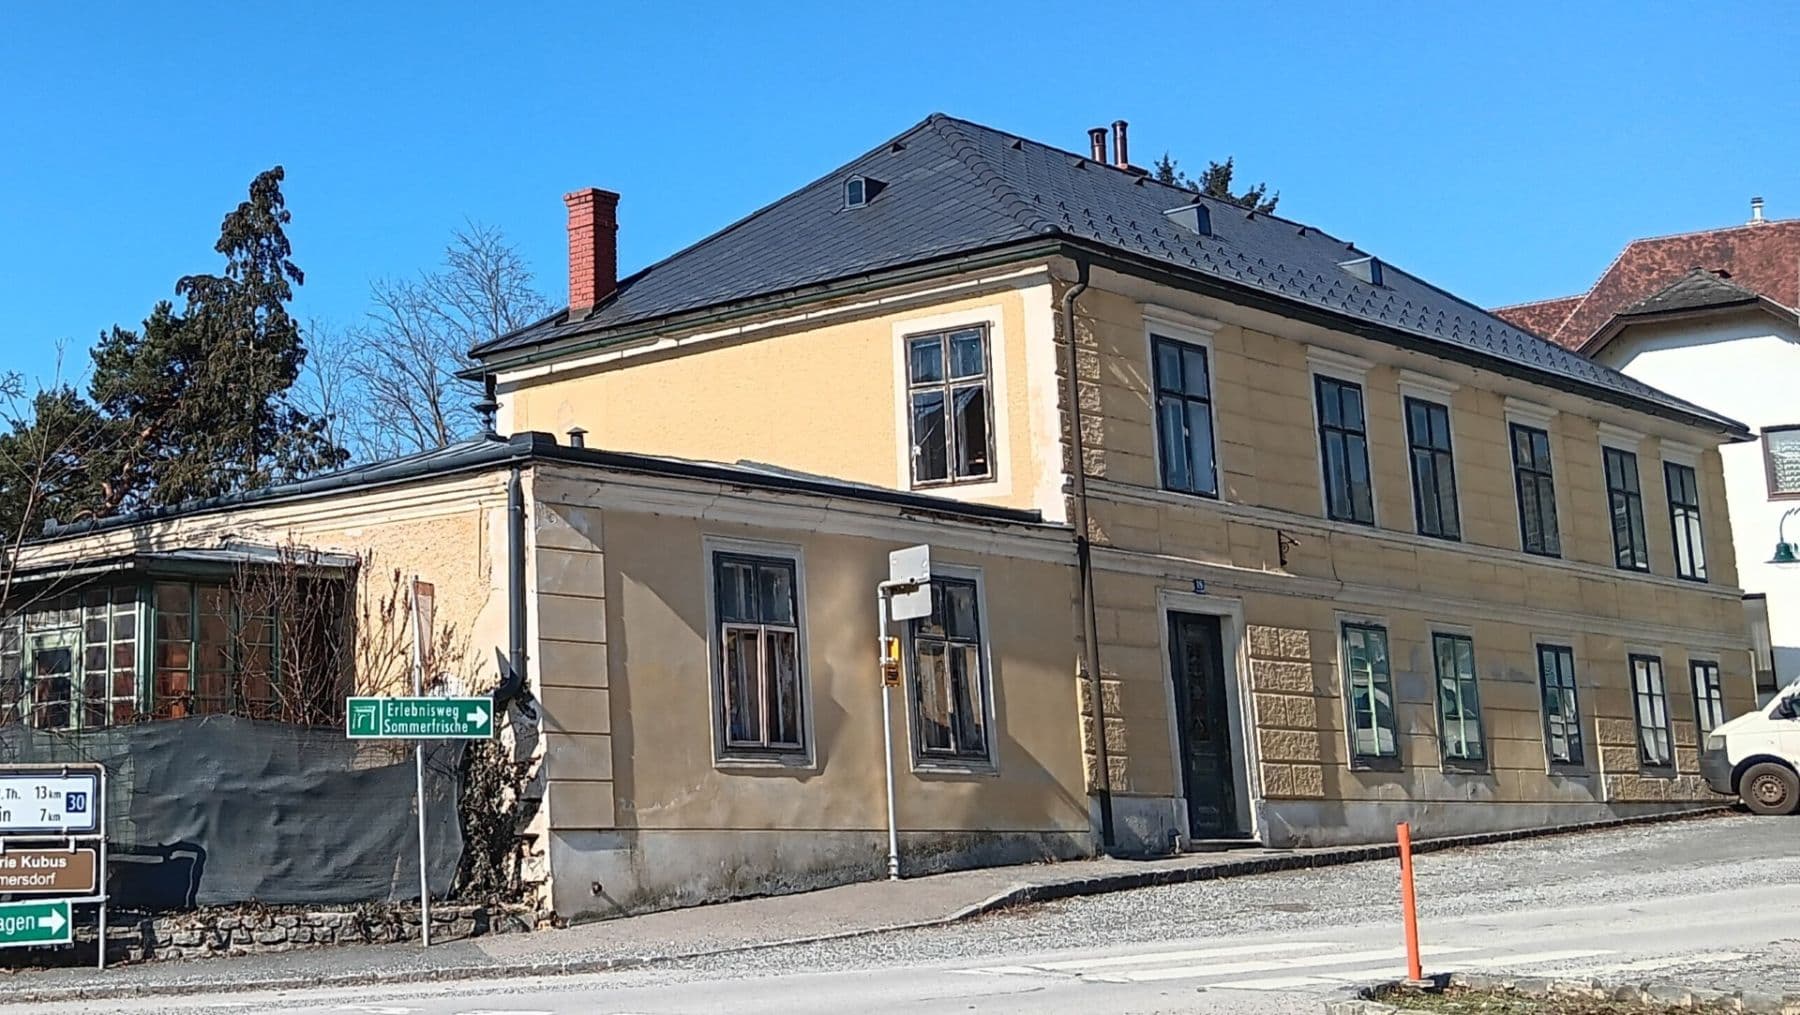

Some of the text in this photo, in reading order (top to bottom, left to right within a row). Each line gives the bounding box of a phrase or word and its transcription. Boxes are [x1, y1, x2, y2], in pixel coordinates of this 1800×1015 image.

[387, 702, 459, 719] Erlebnisweg
[384, 719, 468, 733] Sommerfrische
[68, 794, 85, 811] 30
[40, 808, 47, 822] 7
[21, 855, 67, 868] Kubus
